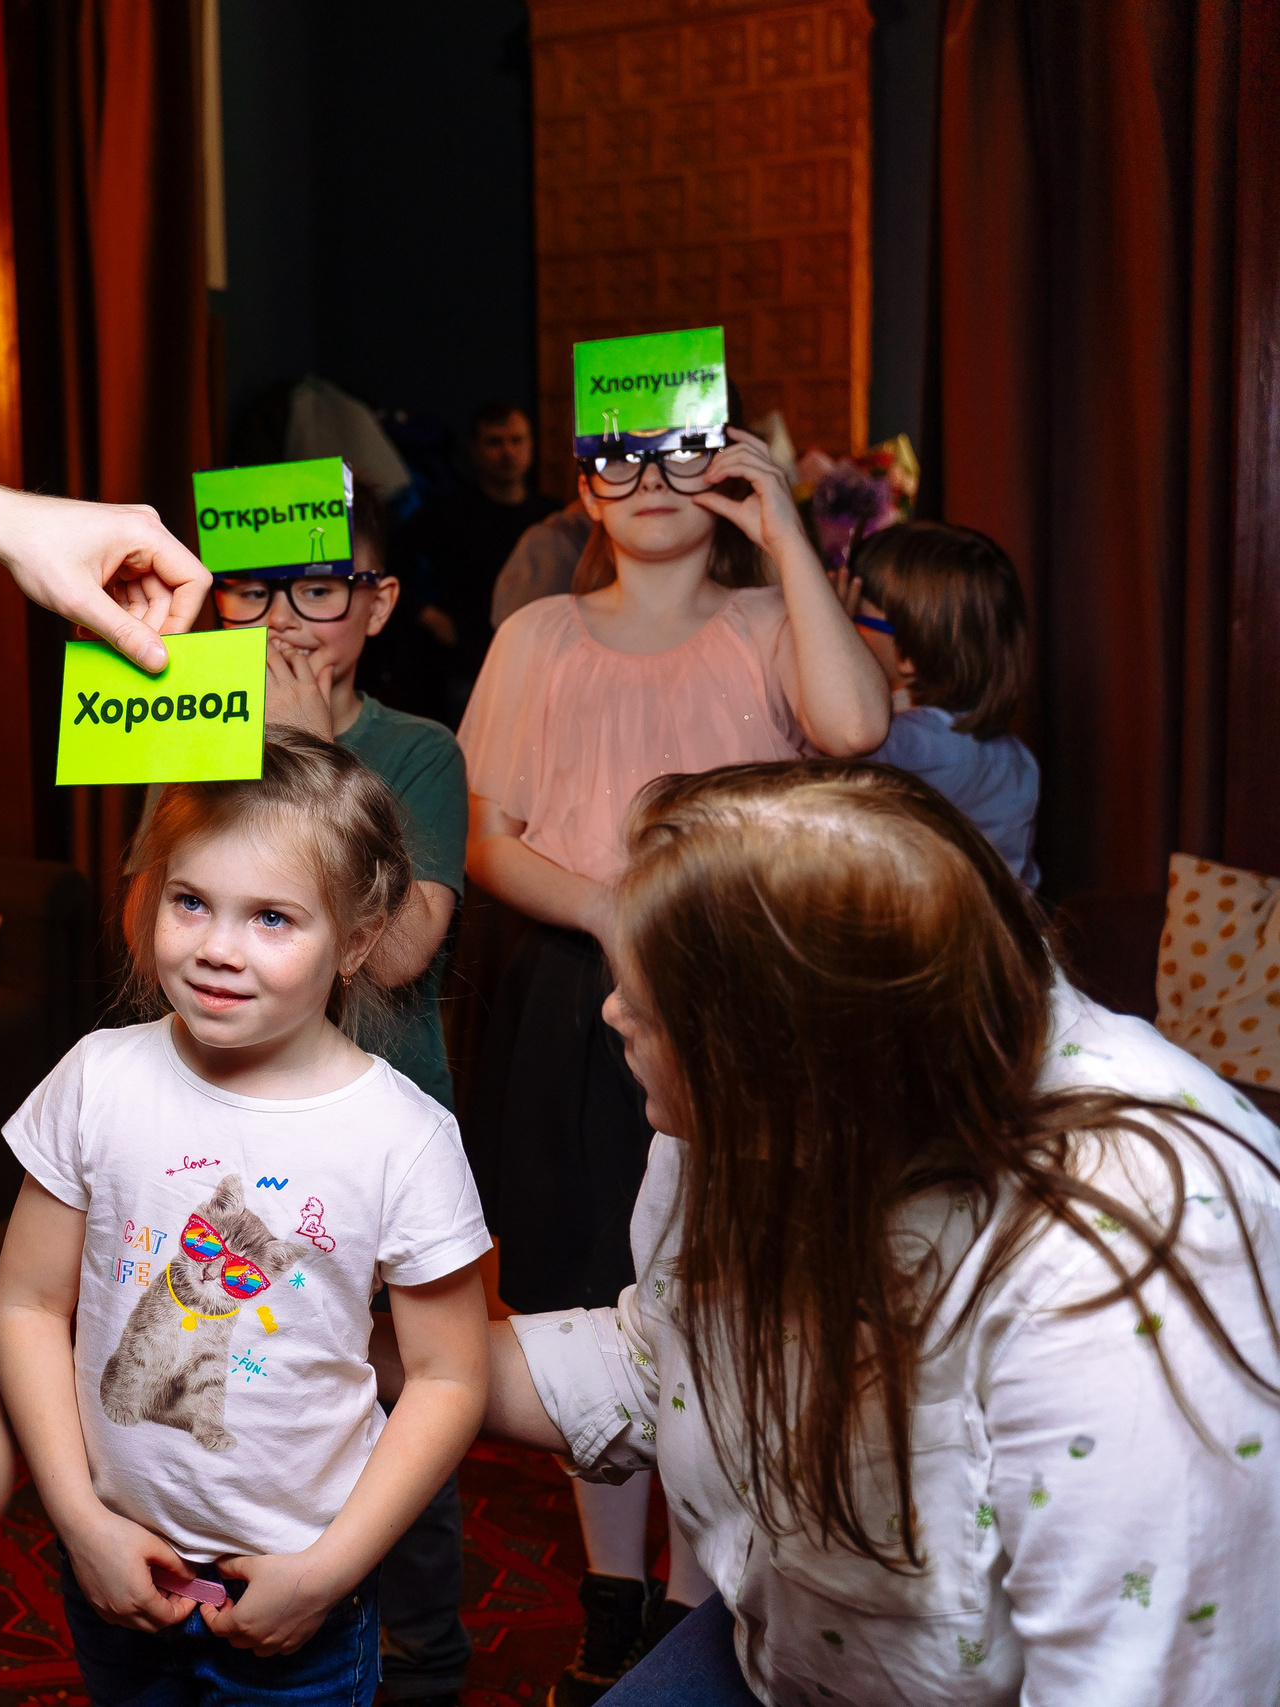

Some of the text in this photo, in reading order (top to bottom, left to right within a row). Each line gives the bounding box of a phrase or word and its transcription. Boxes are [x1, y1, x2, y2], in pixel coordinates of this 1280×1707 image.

[589, 367, 715, 396] Хлопушки
[197, 498, 345, 533] Открытка
[73, 689, 250, 733] Хоровод
[183, 1155, 207, 1169] love
[122, 1219, 168, 1255] CAT
[109, 1256, 151, 1287] LIFE
[238, 1356, 262, 1375] FUN
